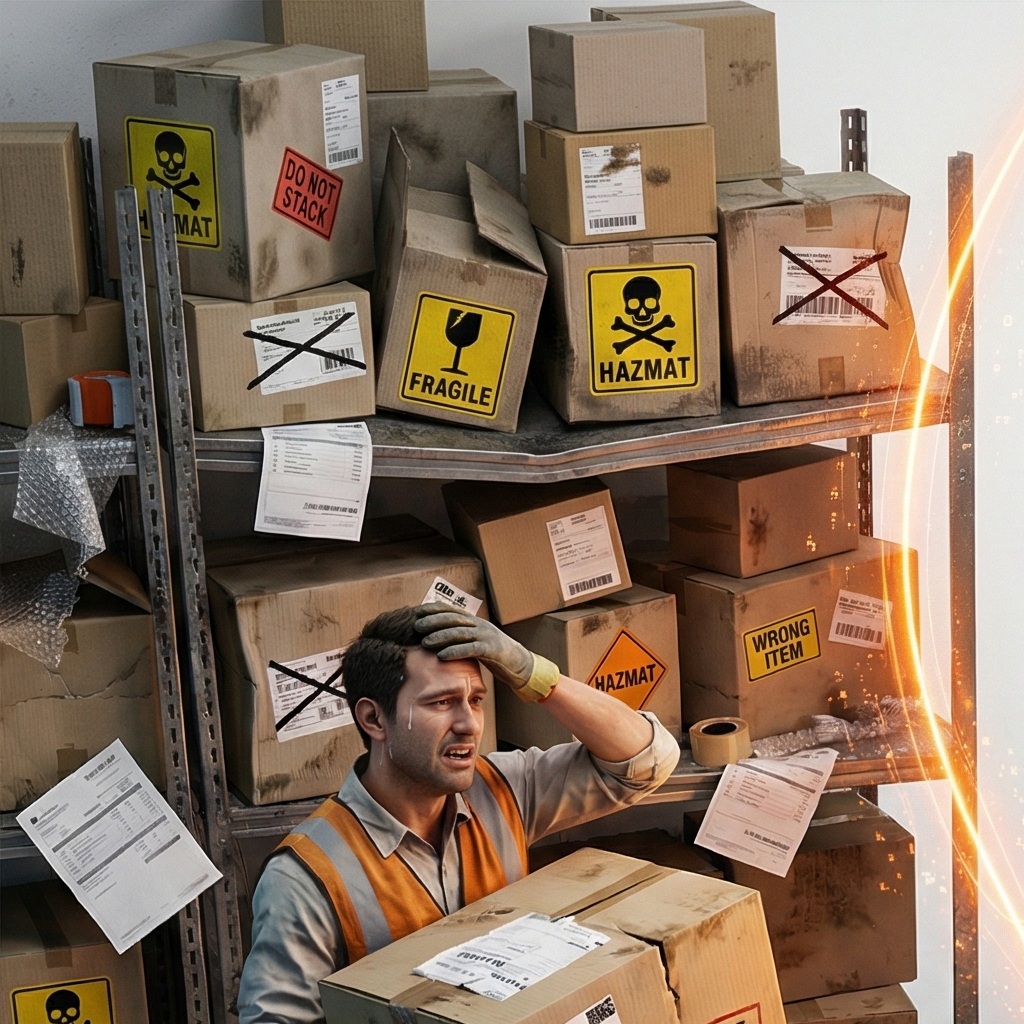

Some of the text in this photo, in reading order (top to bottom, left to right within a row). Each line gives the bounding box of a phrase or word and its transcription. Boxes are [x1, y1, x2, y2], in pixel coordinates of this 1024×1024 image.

[285, 158, 337, 205] DO NOT
[139, 208, 213, 238] HMAT
[282, 186, 328, 229] STACK
[600, 356, 691, 383] HAZMAT
[409, 372, 493, 407] FRAGILE
[752, 618, 811, 653] WRONG
[765, 640, 804, 670] ITEM
[595, 663, 656, 693] HAZMAT
